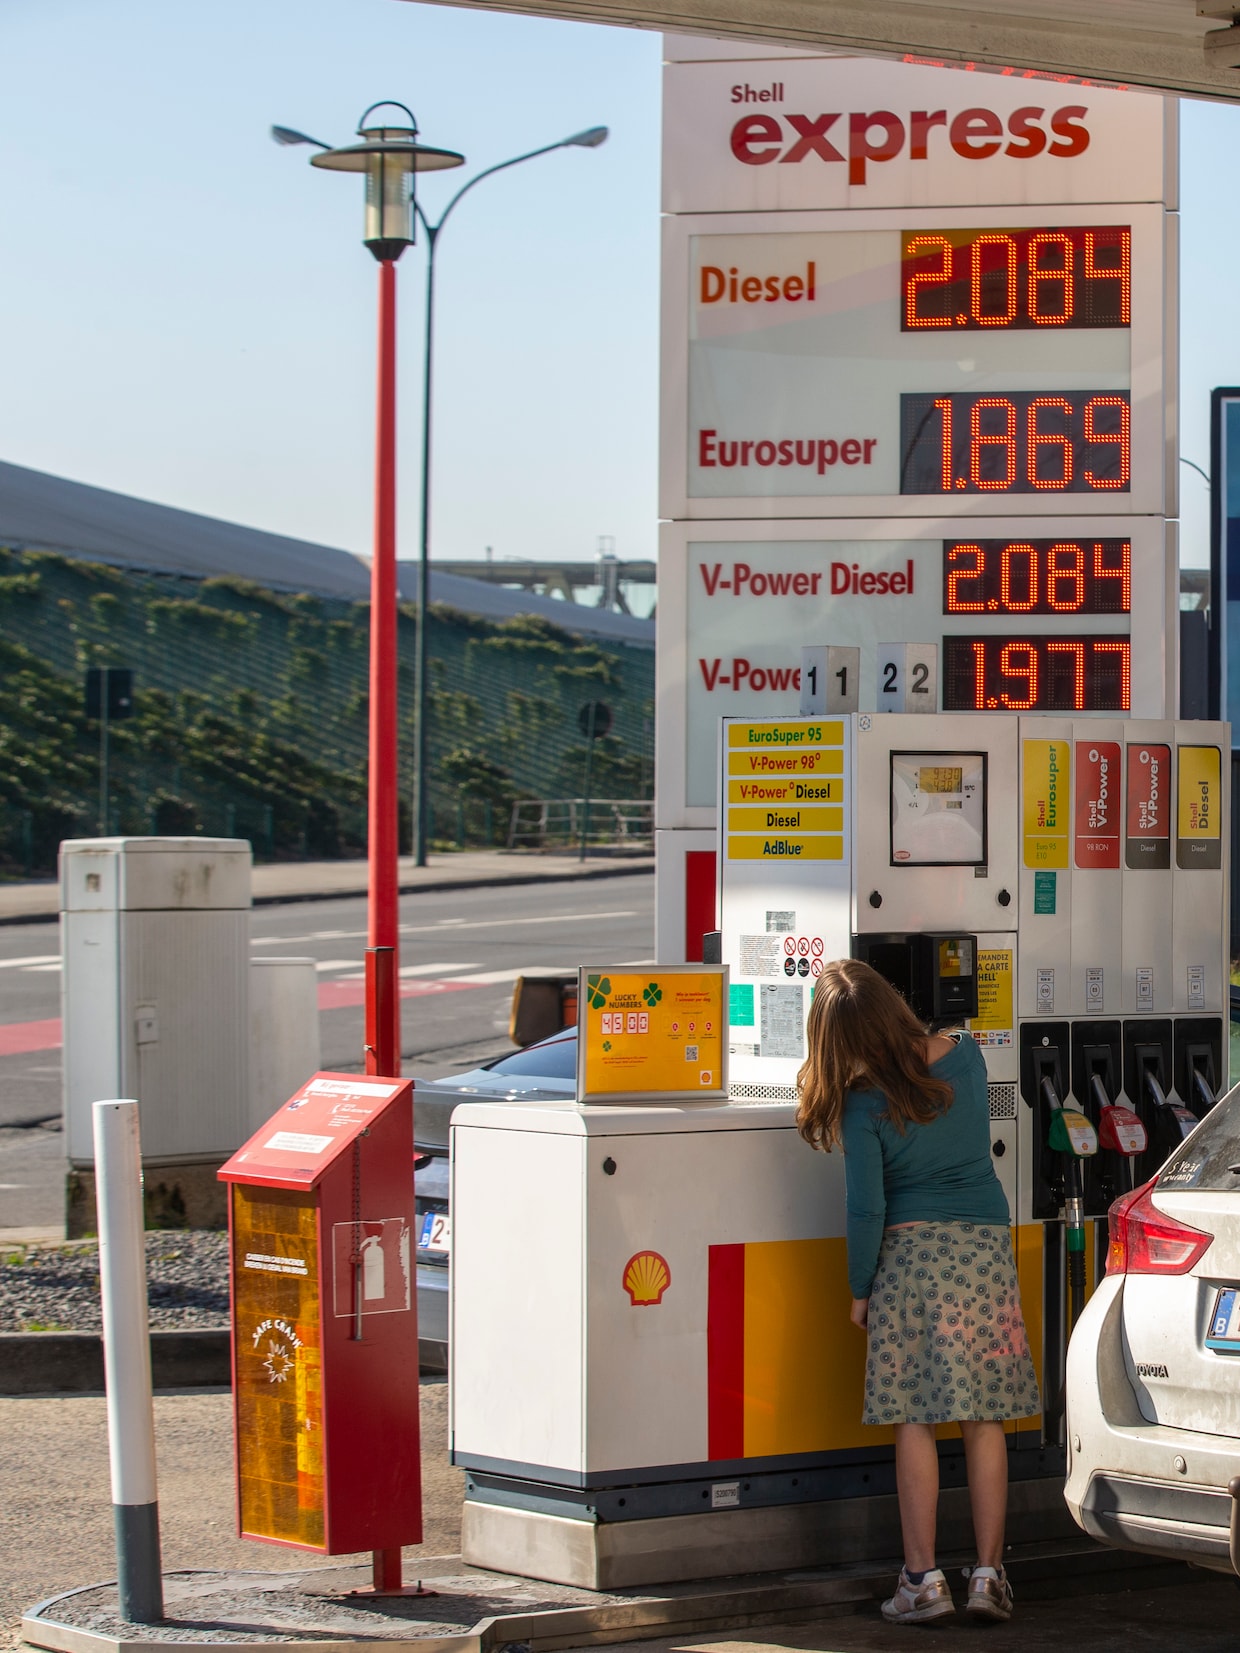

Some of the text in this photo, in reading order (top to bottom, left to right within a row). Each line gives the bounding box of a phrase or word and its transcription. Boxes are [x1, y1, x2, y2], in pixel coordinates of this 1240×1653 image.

[730, 83, 784, 104] Shell
[730, 105, 1090, 185] express
[700, 262, 816, 303] Diesel
[906, 232, 1130, 328] 2.084
[699, 429, 877, 475] Eurosuper
[934, 397, 1130, 490] 1.869
[700, 560, 914, 596] V-Power Diesel
[948, 544, 1130, 611] 2.084
[699, 658, 800, 691] V-Powe
[808, 666, 817, 696] 1
[836, 667, 847, 696] 1
[883, 662, 897, 692] 2
[912, 663, 929, 693] 2
[972, 642, 1130, 709] 1.977
[748, 727, 822, 746] EuroSuper 95
[750, 755, 798, 771] V-Power
[740, 784, 830, 799] V-Power Diesel
[1046, 745, 1059, 827] Eurosuper
[1097, 755, 1108, 828] V-Power
[1147, 756, 1159, 828] V-Power
[767, 812, 800, 827] Diesel
[1037, 800, 1046, 827] Shell
[1089, 801, 1097, 828] Shell
[1139, 802, 1147, 829] Shell
[1190, 802, 1198, 829] Shell
[1198, 781, 1209, 829] Diesel
[763, 840, 801, 855] AdBlue
[1140, 844, 1156, 852] Diesel
[1191, 844, 1207, 852] Diesel
[978, 973, 997, 981] HELL
[985, 963, 1009, 971] CARTE
[252, 1320, 302, 1349] SAFE CRASH
[1216, 1318, 1227, 1333] B
